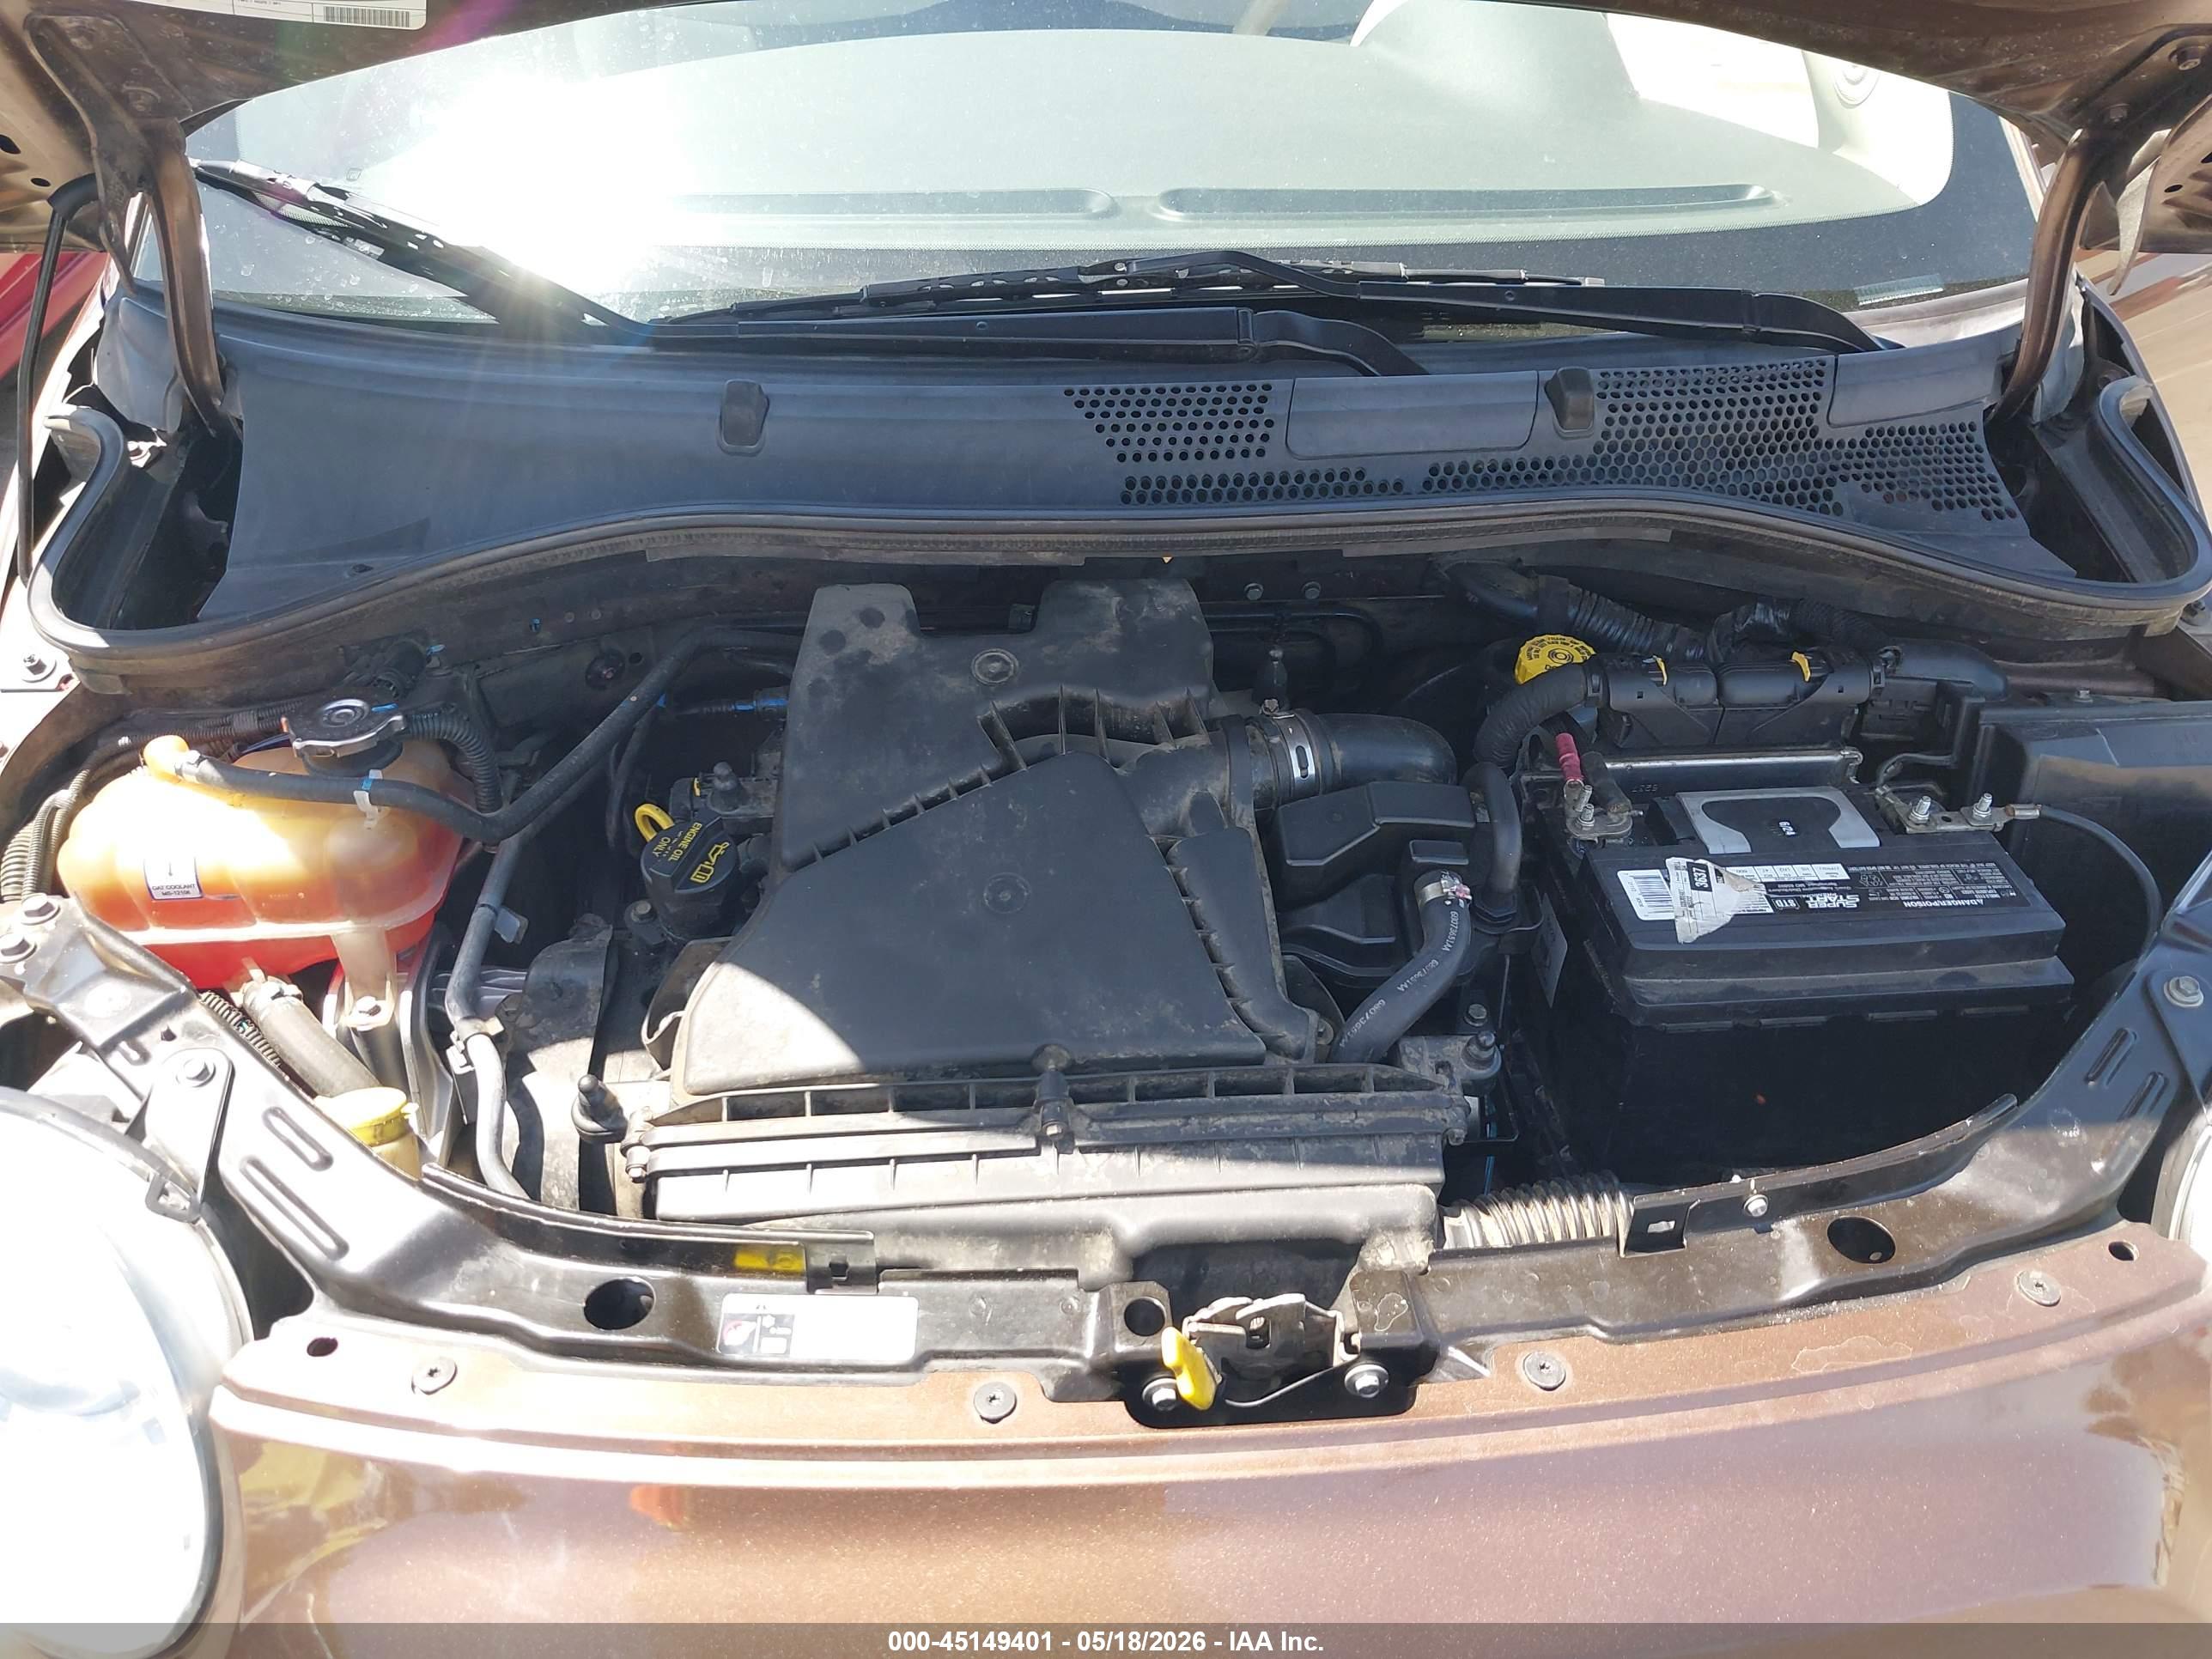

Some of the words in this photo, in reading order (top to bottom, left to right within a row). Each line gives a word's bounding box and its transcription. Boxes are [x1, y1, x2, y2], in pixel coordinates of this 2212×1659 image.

[678, 822, 702, 849] ENGINE
[653, 836, 672, 858] ONLY
[668, 849, 684, 862] OIL
[1692, 866, 1709, 889] 3637
[1805, 894, 1861, 903] START
[1904, 899, 1978, 908] DANGER/POISON
